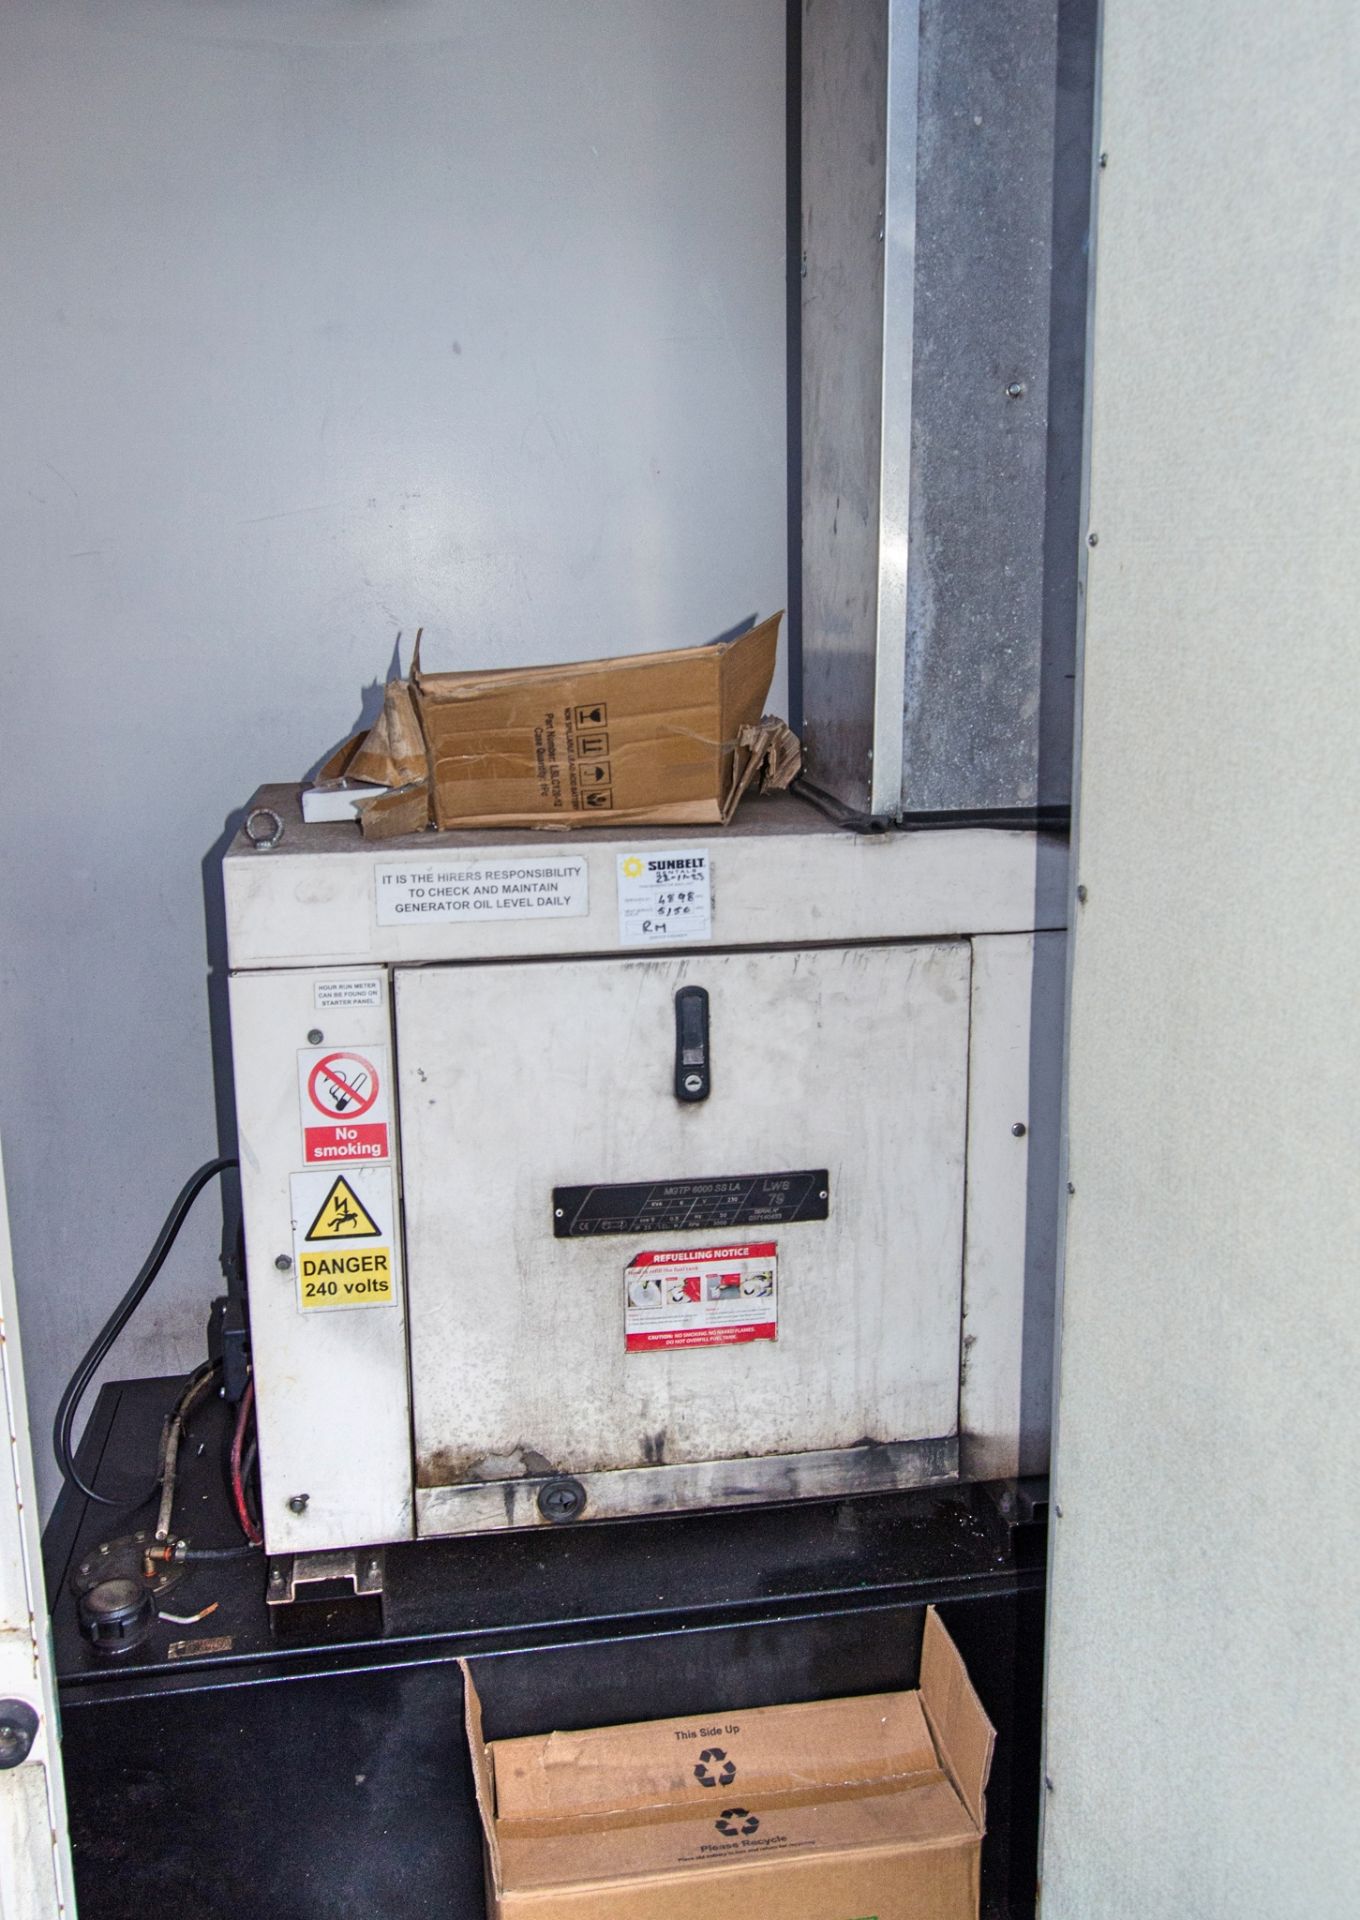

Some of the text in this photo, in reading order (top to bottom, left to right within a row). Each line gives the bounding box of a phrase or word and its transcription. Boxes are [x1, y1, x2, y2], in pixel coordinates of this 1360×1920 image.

[545, 713, 554, 730] Part
[534, 728, 544, 746] Case
[547, 732, 557, 762] Number:
[648, 858, 704, 871] SUNBELT
[382, 868, 581, 884] IT IS THE HIRERS RESPONSIBILITY
[408, 883, 558, 898] TO CHECK AND MAINTAIN
[394, 896, 571, 913] GENERATOR OIL LEVEL DAILY
[335, 1127, 358, 1140] No
[314, 1143, 382, 1158] smoking
[653, 1248, 750, 1263] REFUELLING NOTICE
[303, 1254, 388, 1277] DANGER
[306, 1278, 389, 1298] 240 volts
[674, 1725, 740, 1740] This Side Up
[700, 1835, 788, 1852] Please Recycle
